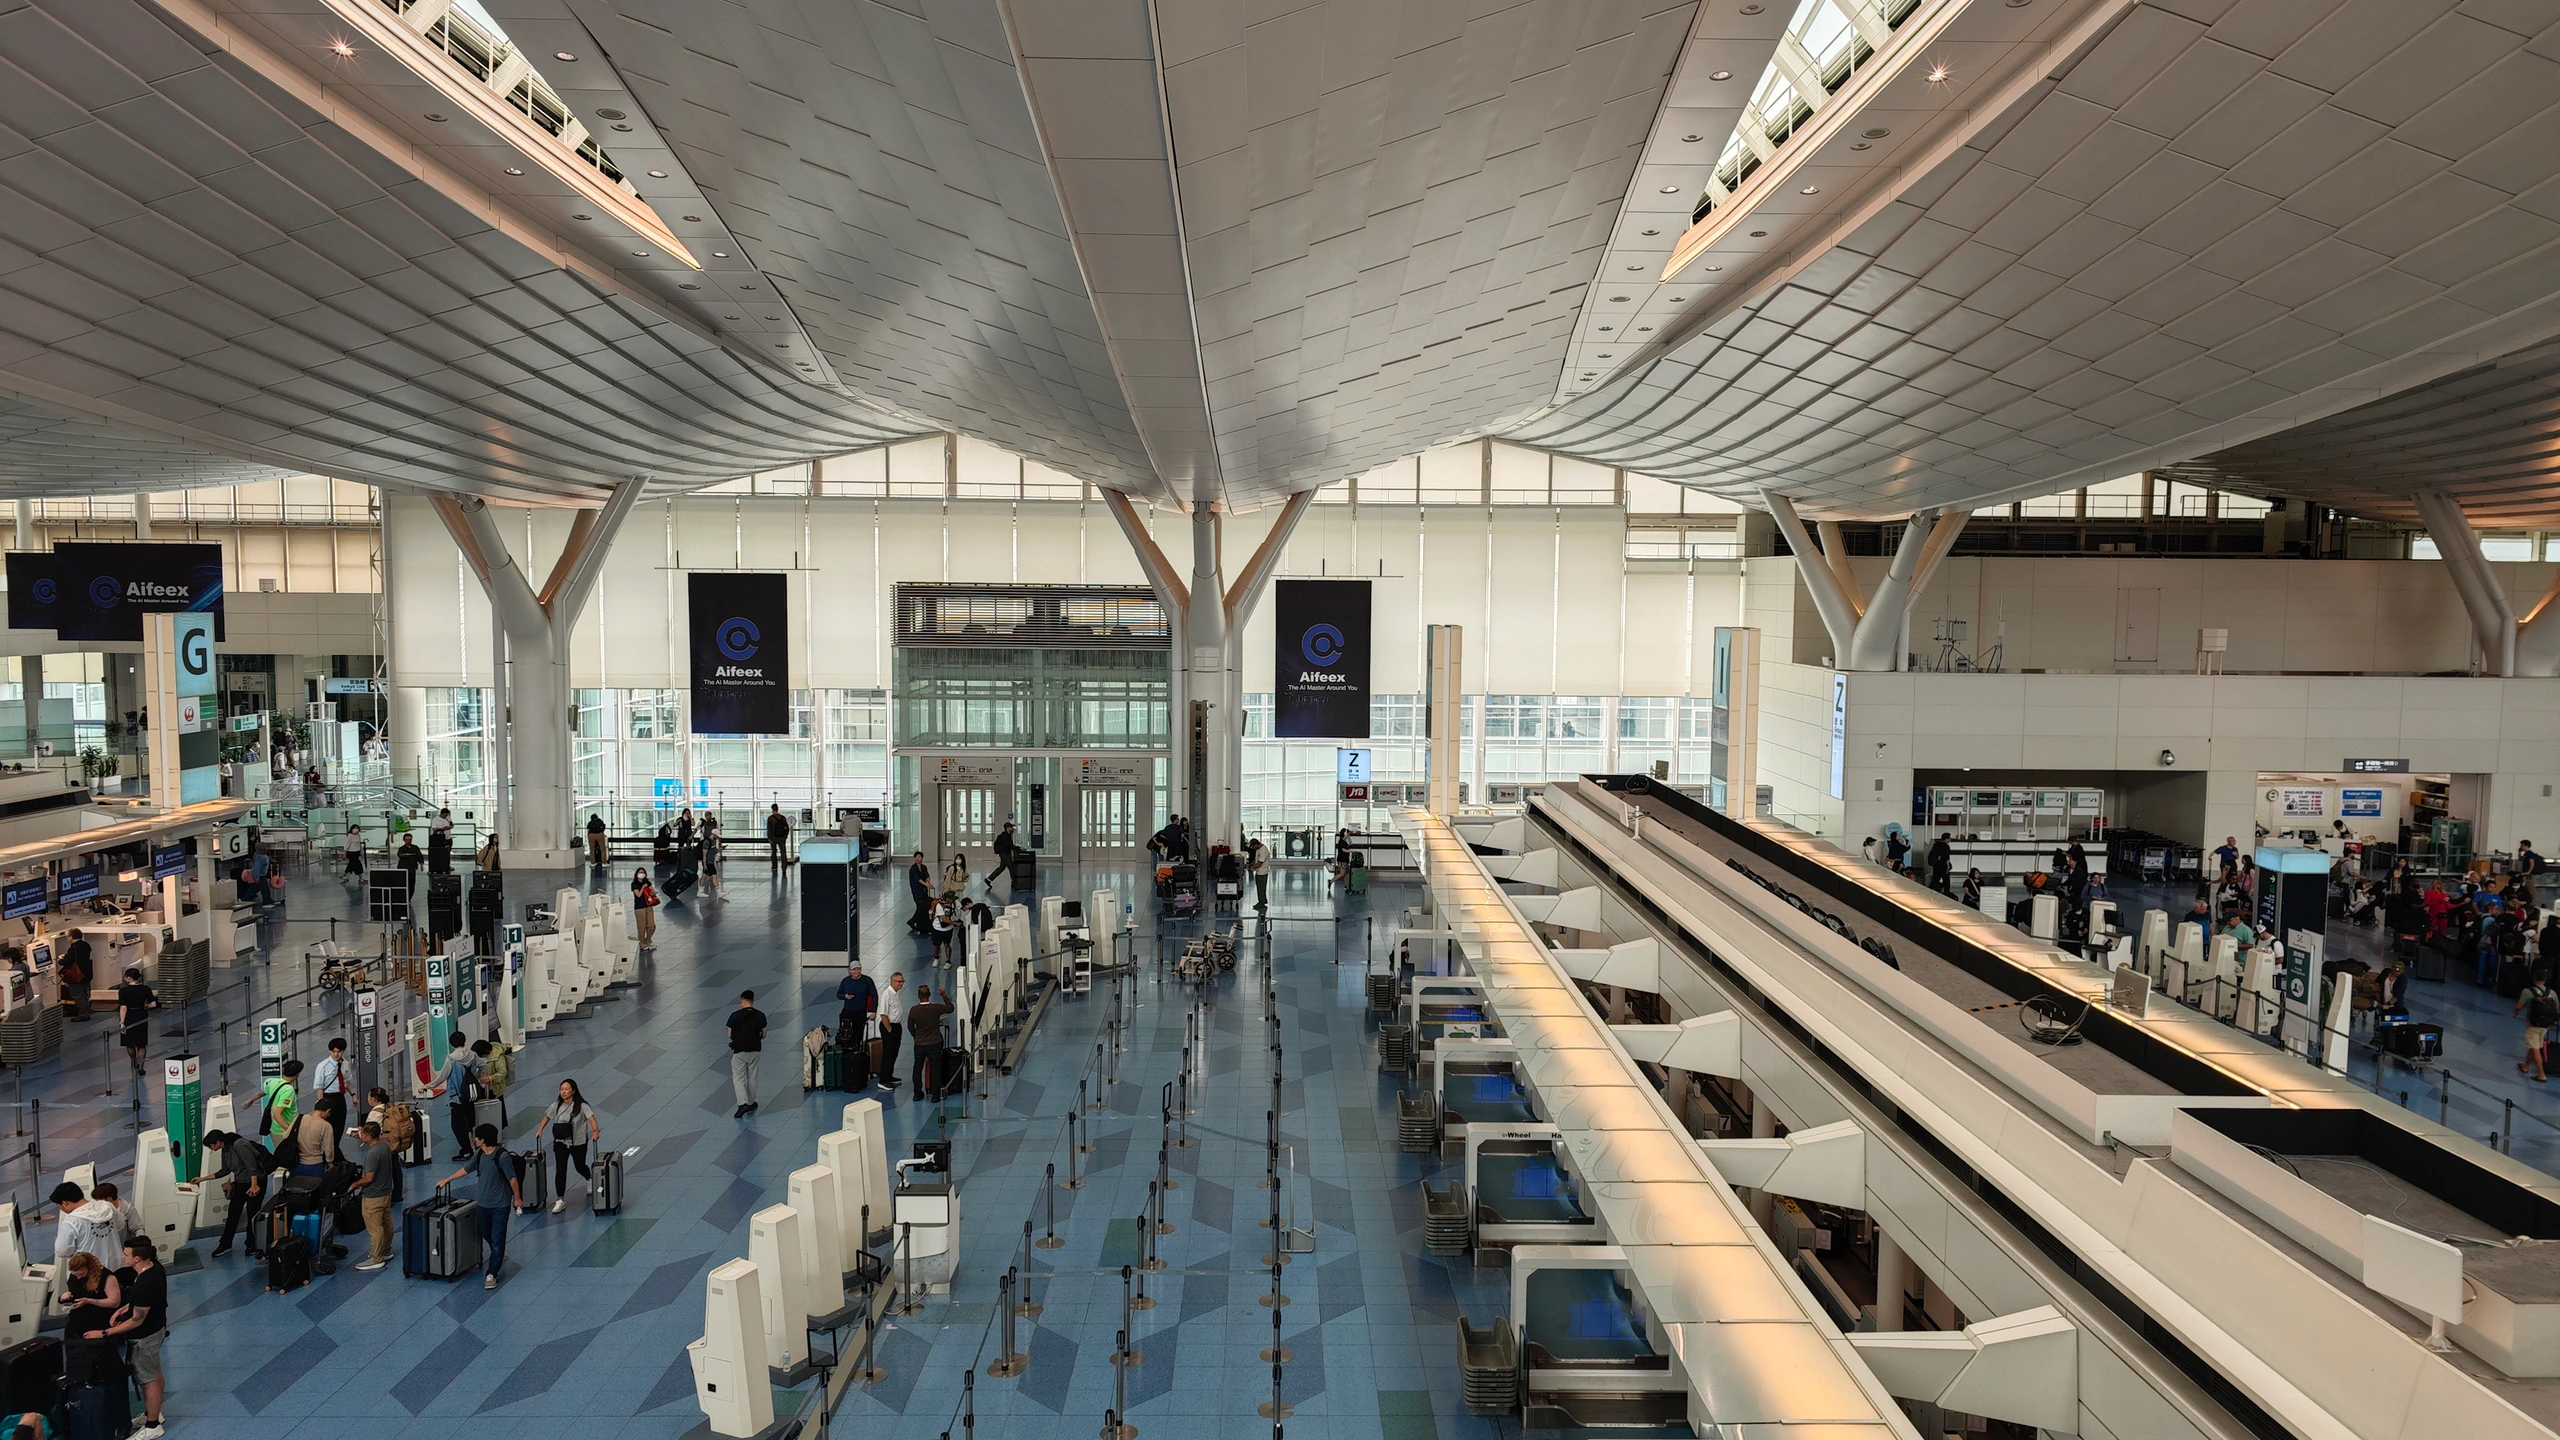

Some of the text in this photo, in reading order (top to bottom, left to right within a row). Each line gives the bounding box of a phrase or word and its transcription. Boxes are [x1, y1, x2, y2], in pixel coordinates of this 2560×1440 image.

[126, 582, 189, 597] Aifeex
[182, 628, 208, 675] G
[715, 666, 763, 677] Aifeex
[1300, 672, 1346, 682] Aifeex
[1836, 682, 1844, 712] Z
[1349, 753, 1359, 766] Z
[1349, 788, 1364, 797] JTB
[230, 834, 241, 853] G
[511, 931, 517, 941] 1
[430, 963, 439, 975] 2
[444, 961, 449, 974] 2
[264, 1027, 275, 1042] 3
[282, 1024, 286, 1039] 3
[1720, 1116, 1730, 1130] 7
